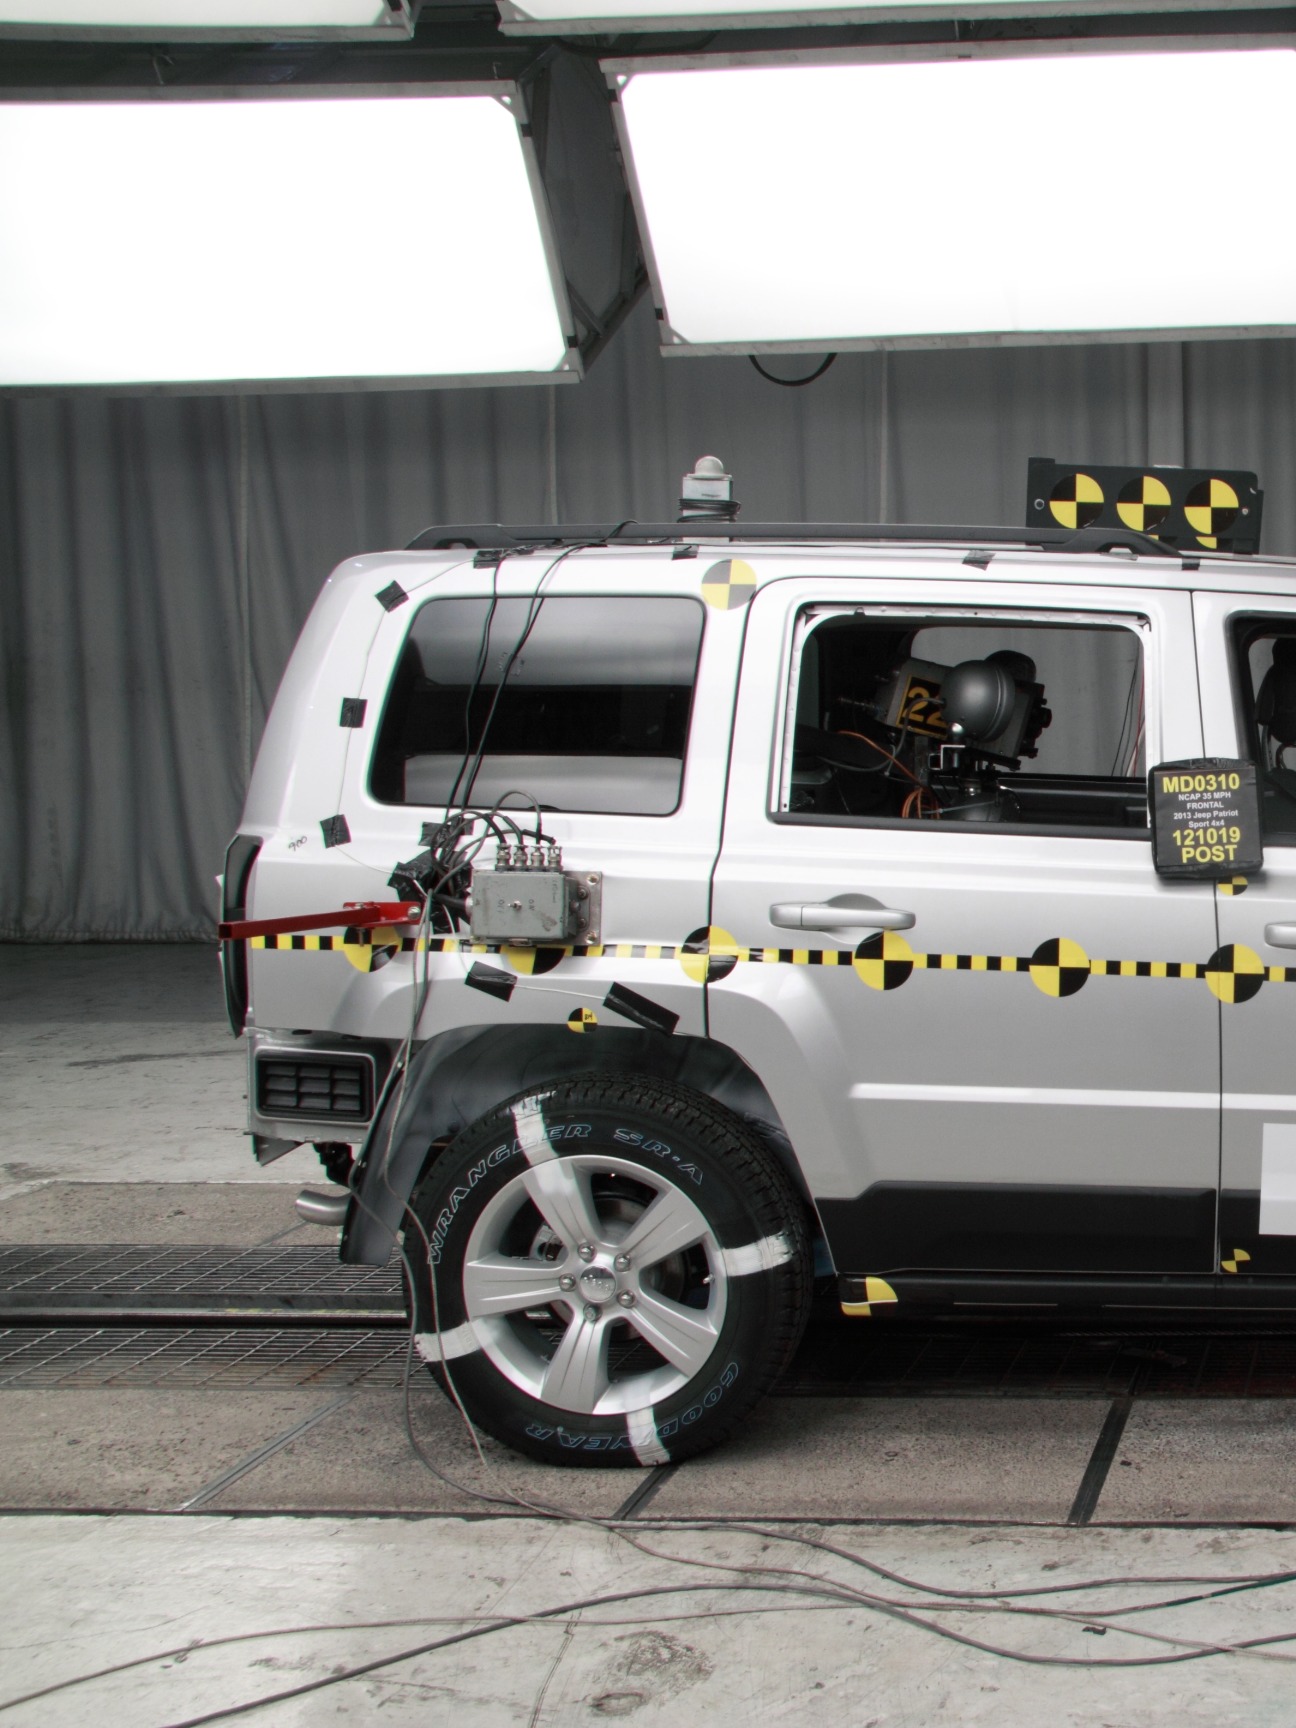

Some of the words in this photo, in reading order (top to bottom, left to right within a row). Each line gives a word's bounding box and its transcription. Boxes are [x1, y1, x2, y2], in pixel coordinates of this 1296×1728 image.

[1162, 773, 1240, 793] MD0310
[1178, 793, 1200, 801] NCAP
[1186, 801, 1224, 809] FRONTAL
[1173, 812, 1192, 820] 2013
[1193, 811, 1211, 819] Jeep
[1213, 809, 1238, 818] Patriot
[1188, 820, 1210, 829] Sport
[1211, 819, 1225, 827] 4x4
[1172, 827, 1241, 846] 121019
[1181, 844, 1238, 863] POST
[427, 1124, 592, 1265] WRANGLER
[525, 1362, 739, 1451] GOODYEAR
